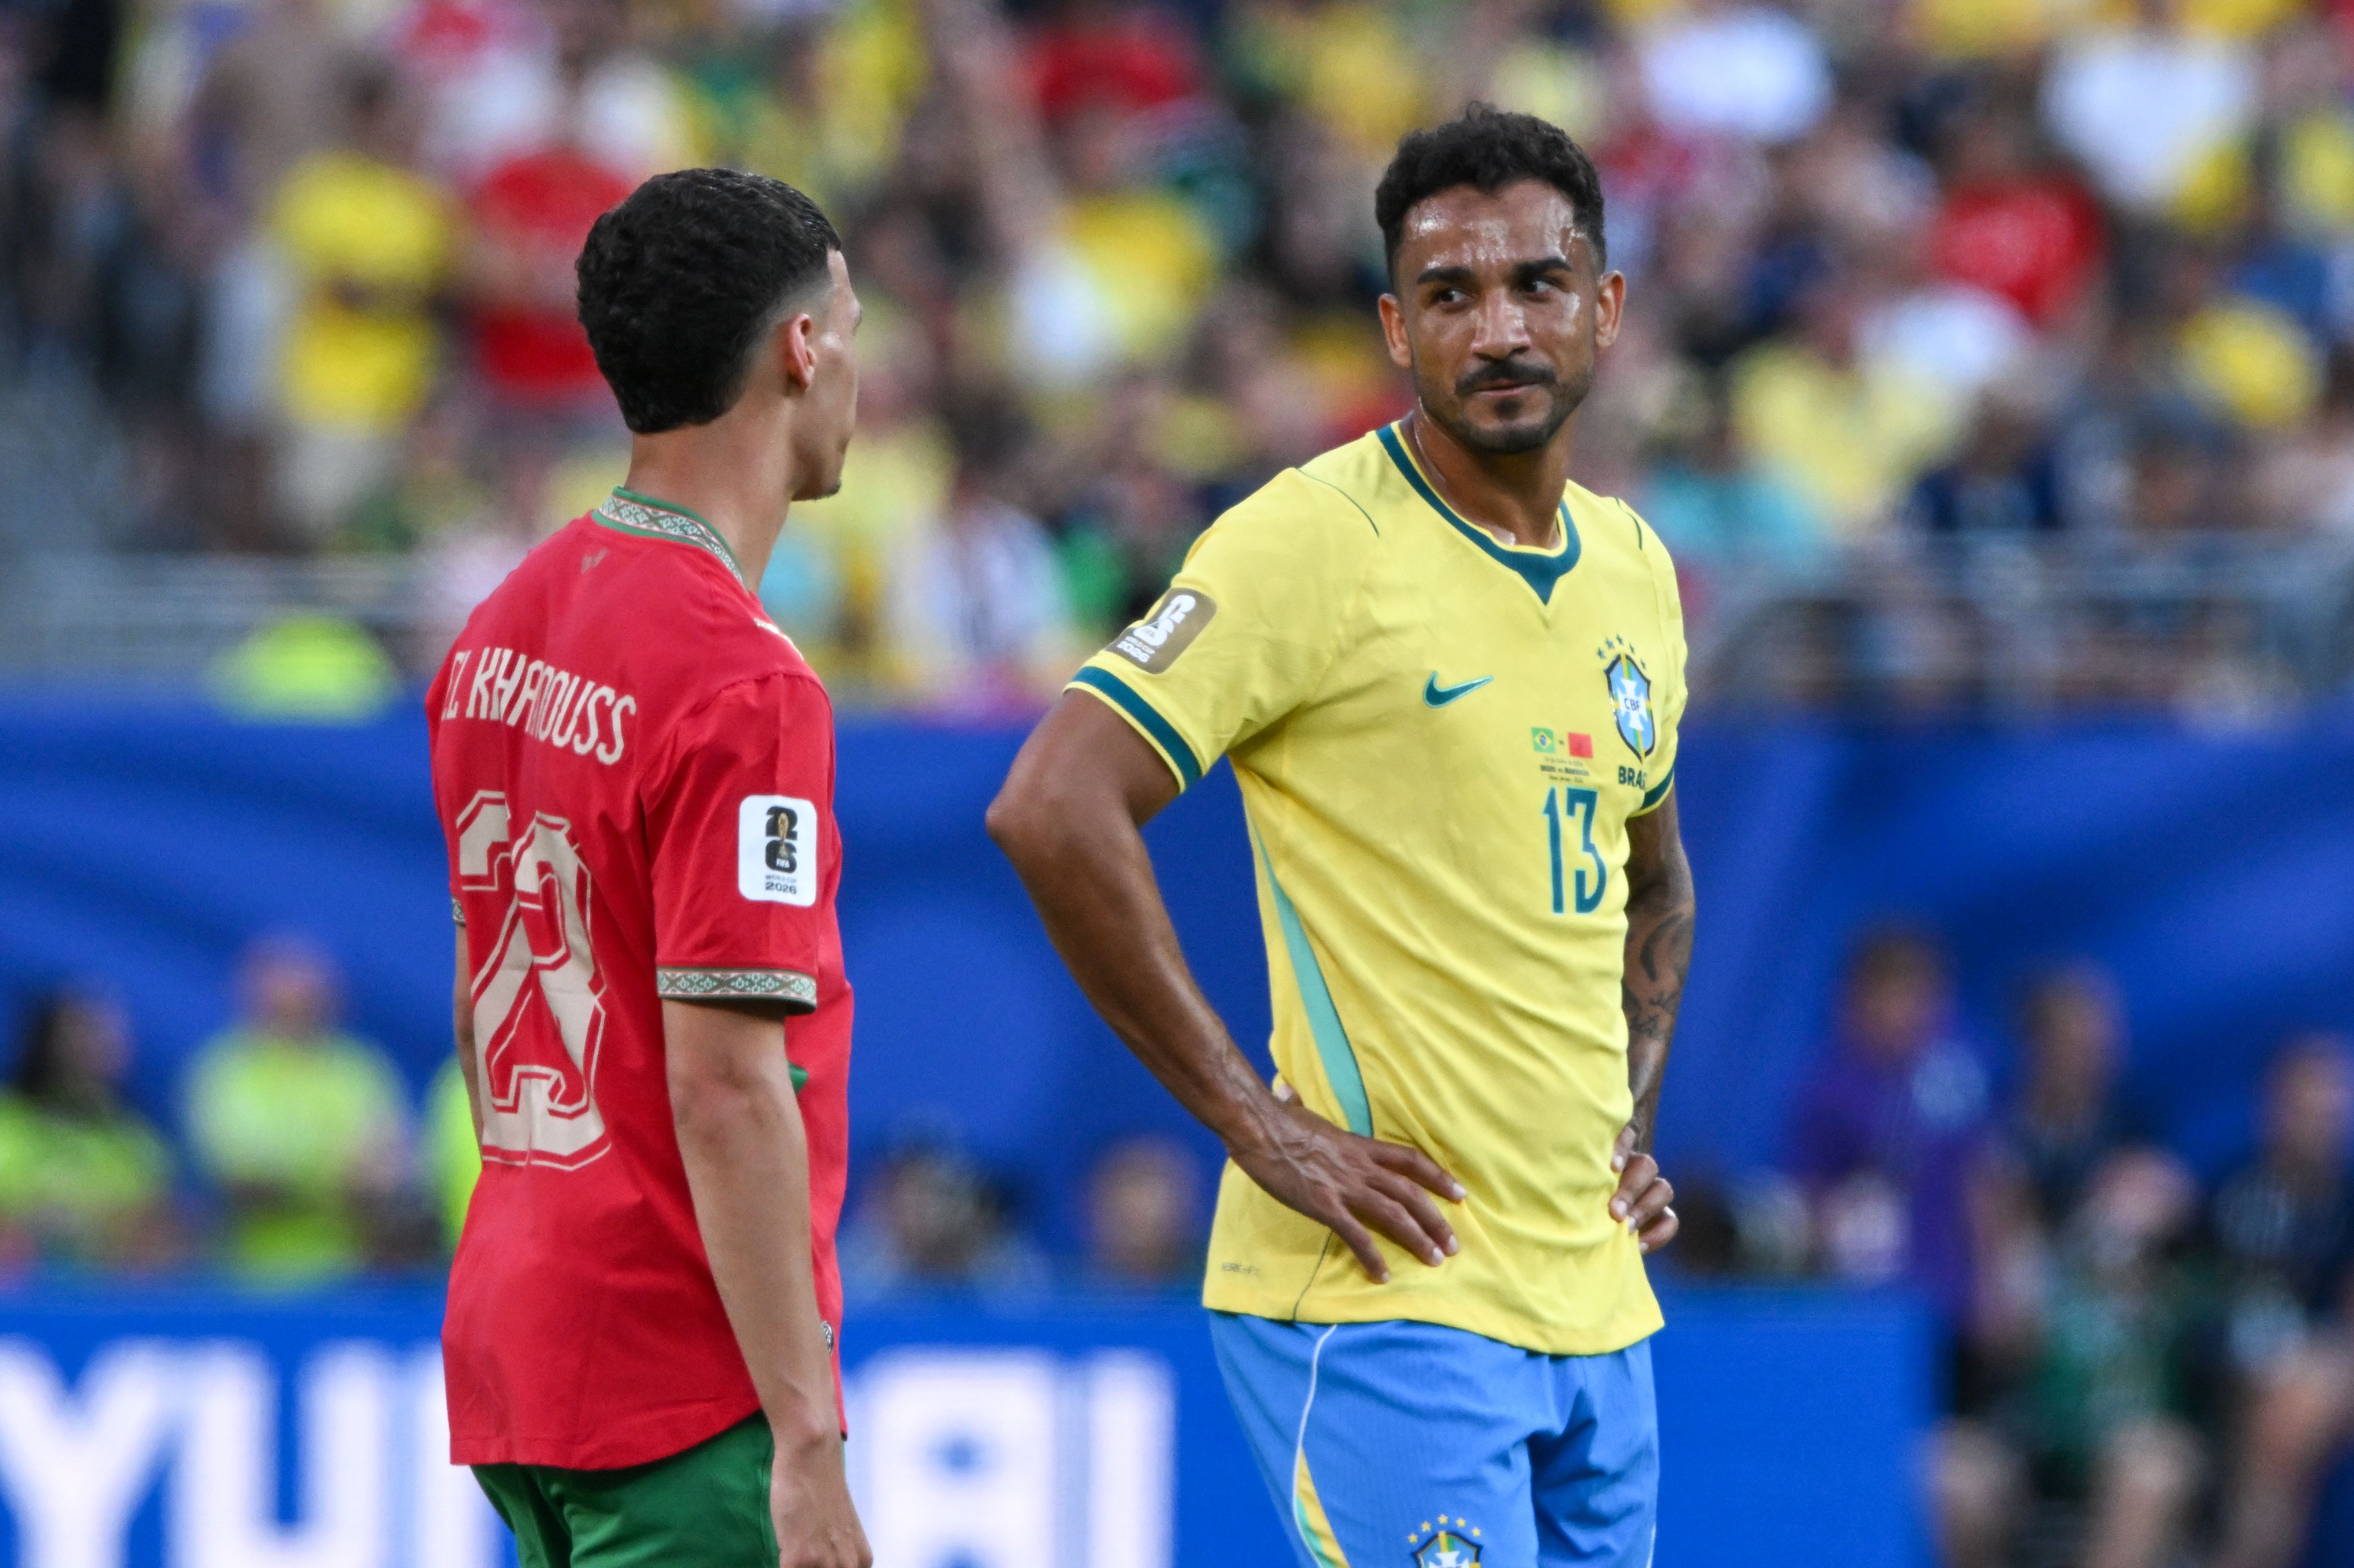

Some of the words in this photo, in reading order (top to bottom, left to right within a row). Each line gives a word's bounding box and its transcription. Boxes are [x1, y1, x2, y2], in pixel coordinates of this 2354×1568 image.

[1624, 698, 1641, 711] CBF
[1542, 785, 1608, 916] 13
[776, 858, 791, 869] FIFA
[765, 881, 797, 895] 2026
[0, 1333, 1178, 1568] YUAI
